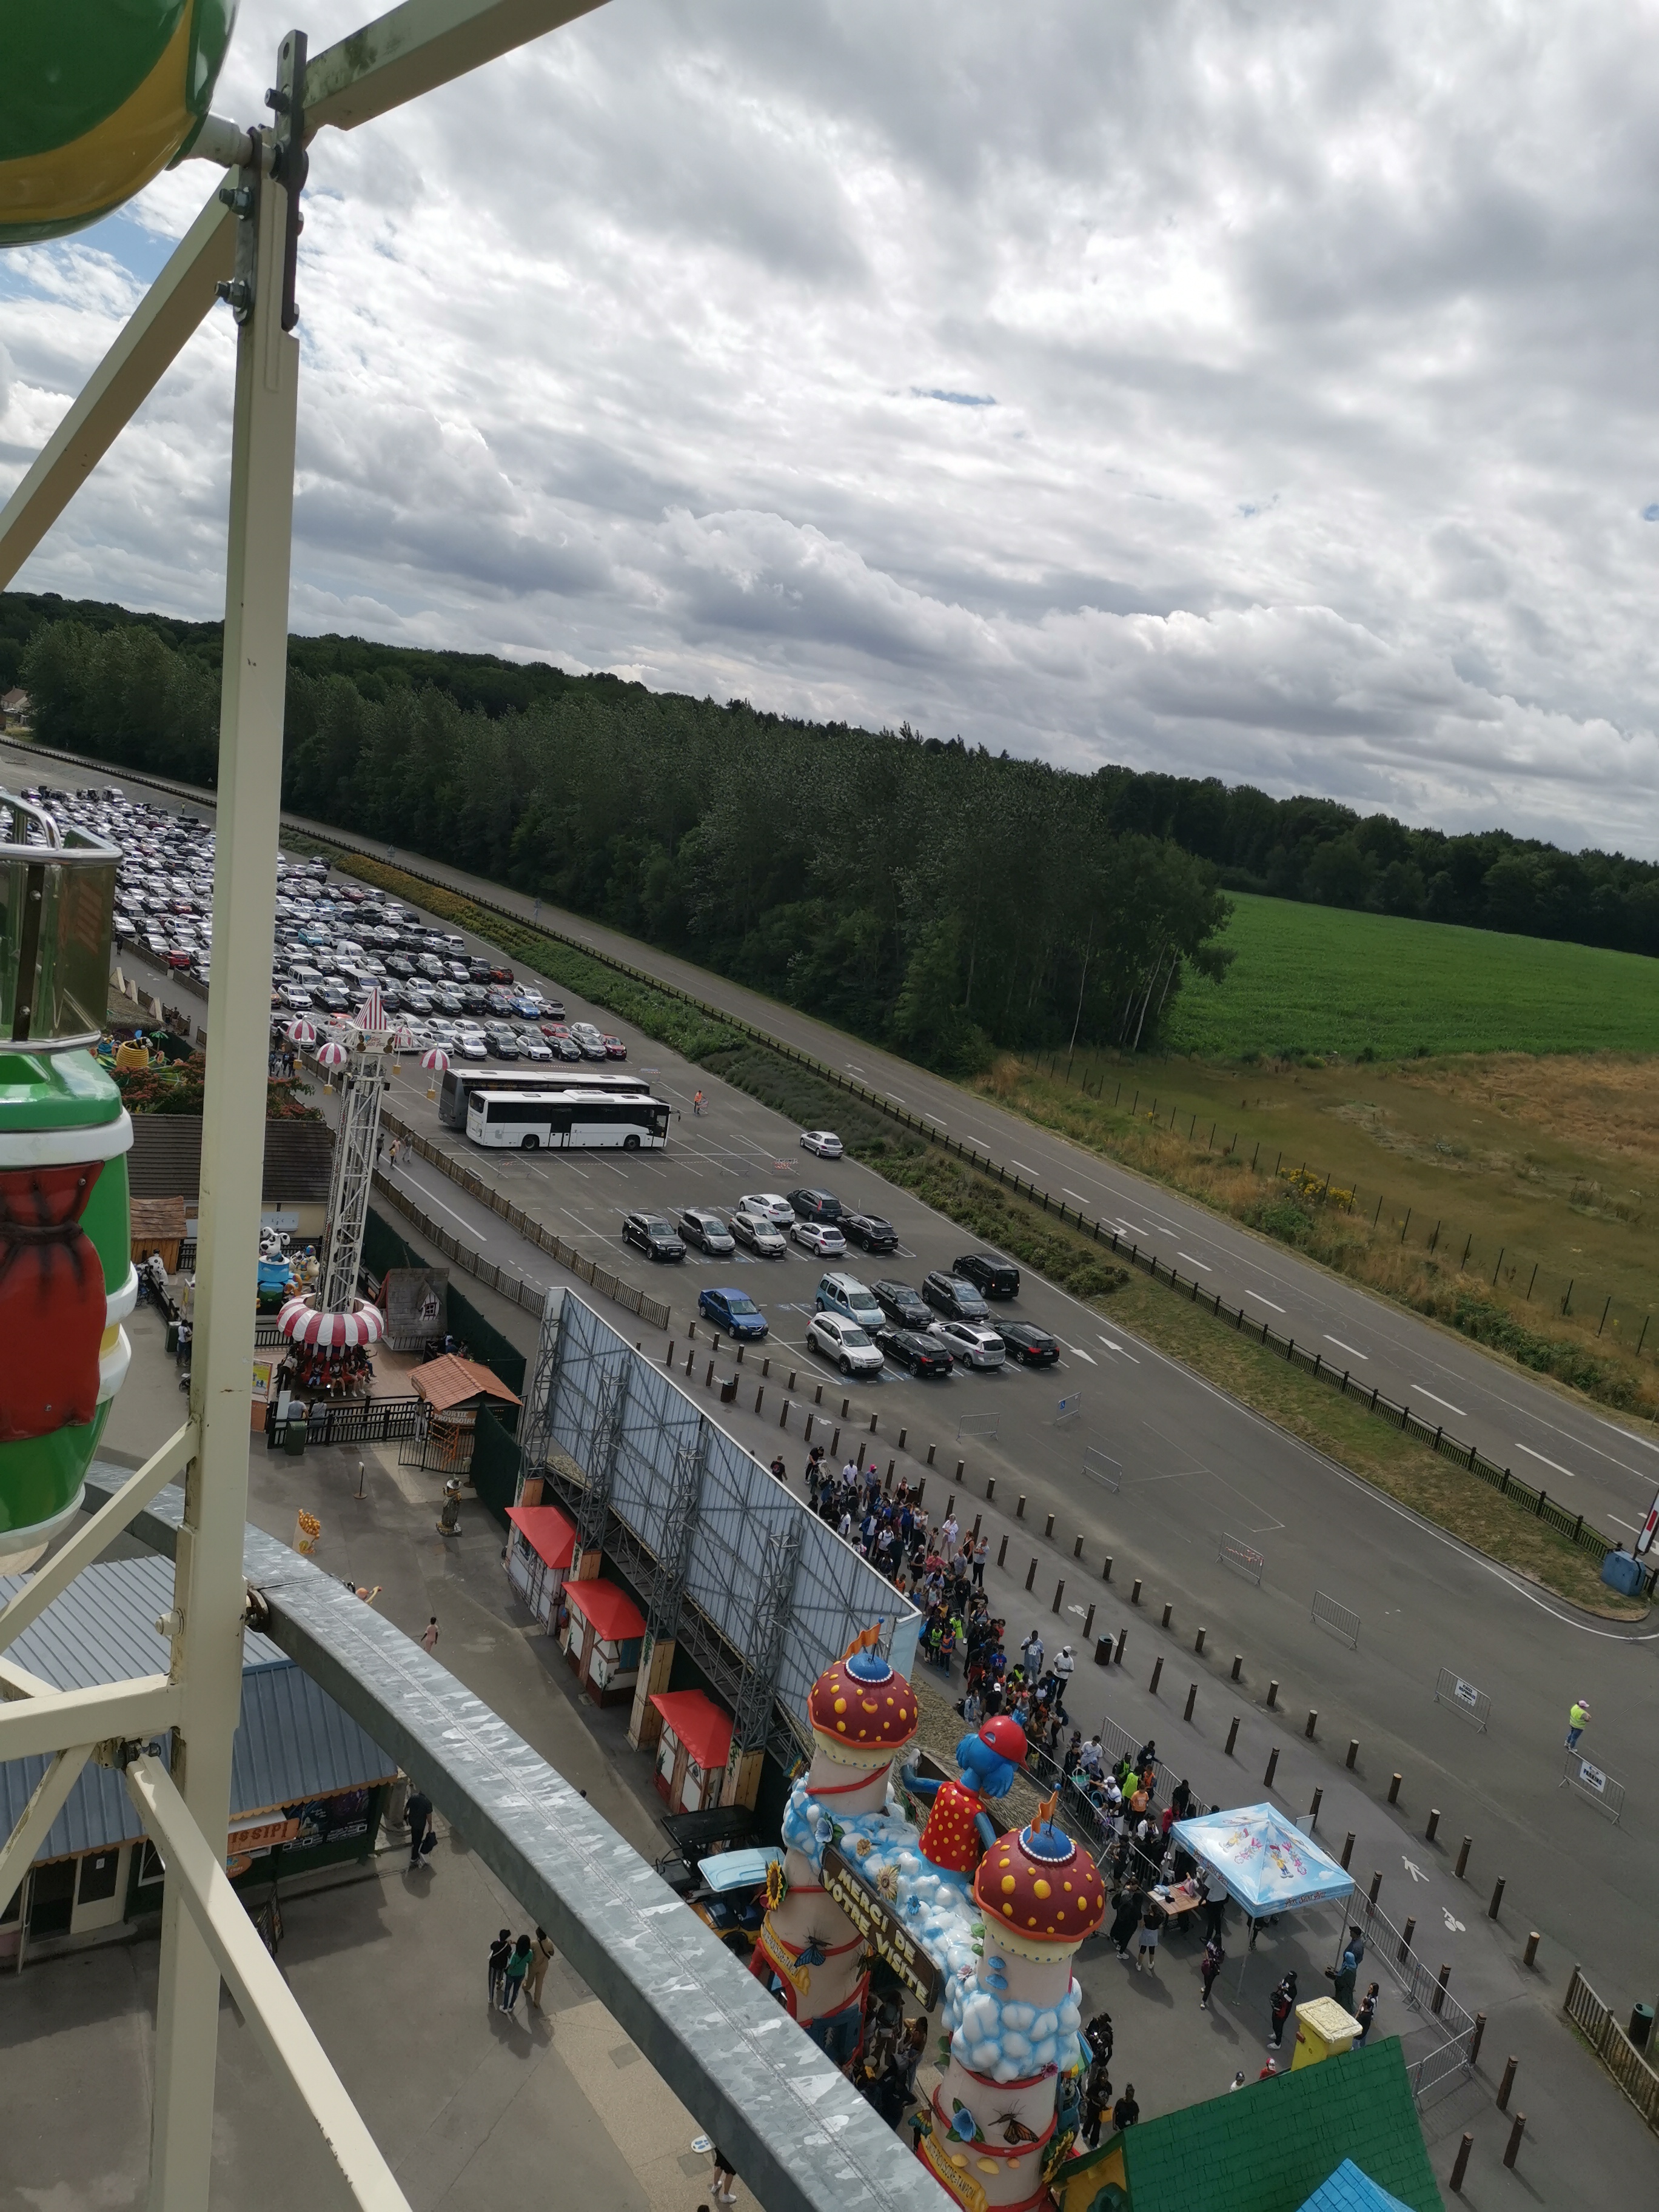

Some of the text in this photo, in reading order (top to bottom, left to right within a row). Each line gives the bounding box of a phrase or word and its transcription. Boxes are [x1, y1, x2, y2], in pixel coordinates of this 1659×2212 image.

[443, 1410, 468, 1418] SORTIE
[1583, 1768, 1603, 1786] PARKING
[231, 1822, 289, 1844] ISSIPI
[838, 1868, 916, 1965] MERCI DE
[823, 1868, 930, 2006] VOTRE VISITE
